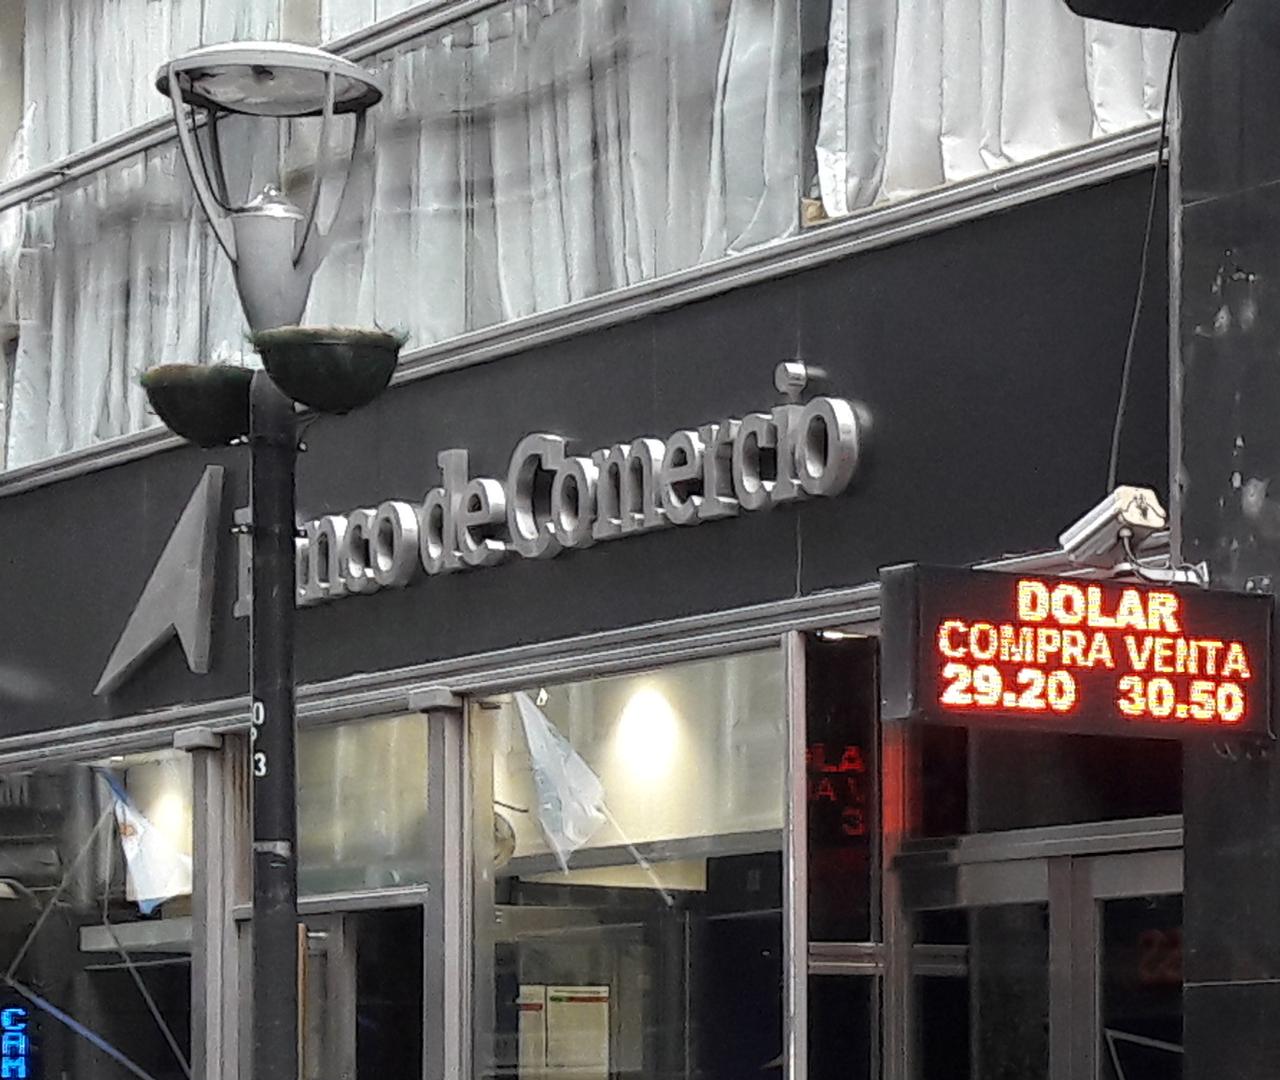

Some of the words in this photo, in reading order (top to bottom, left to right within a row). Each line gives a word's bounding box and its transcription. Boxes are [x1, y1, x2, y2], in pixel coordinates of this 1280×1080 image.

[420, 448, 507, 575] de
[507, 359, 862, 559] Comercio
[1017, 579, 1181, 632] DOLAR
[938, 621, 1115, 668] COMPRA
[1123, 635, 1251, 678] VENTA
[939, 662, 1077, 712] 29.20
[1117, 676, 1246, 722] 30.50
